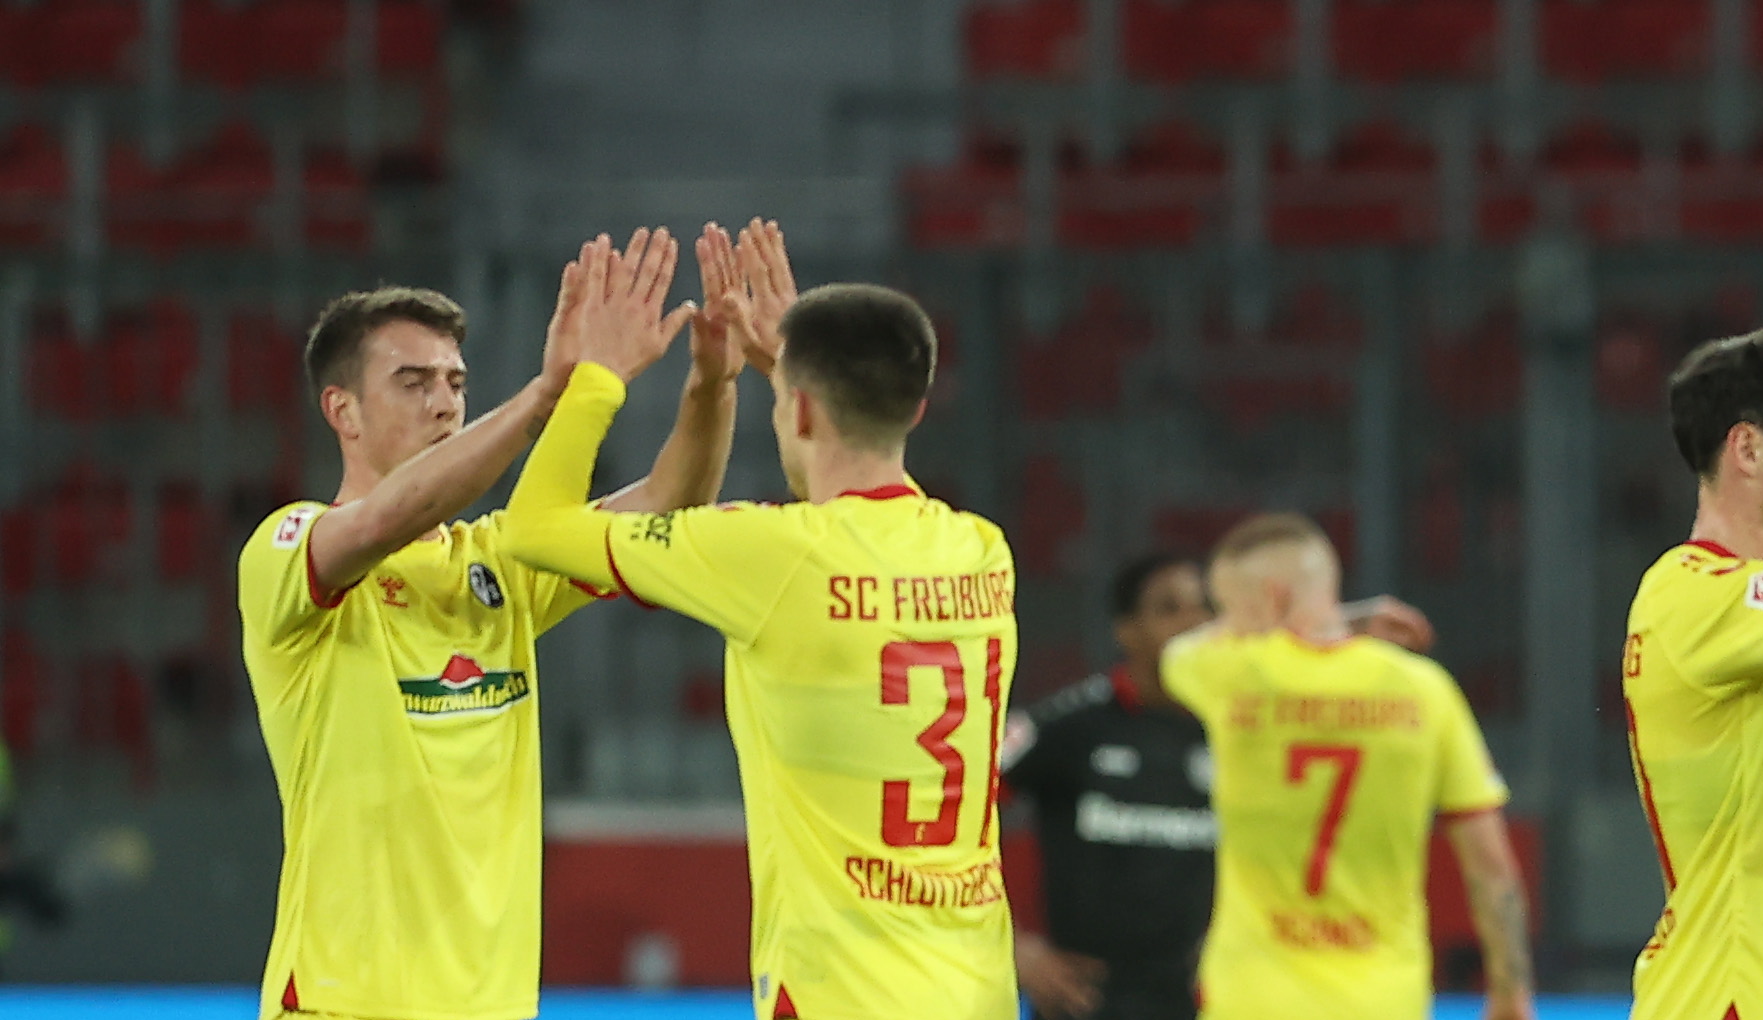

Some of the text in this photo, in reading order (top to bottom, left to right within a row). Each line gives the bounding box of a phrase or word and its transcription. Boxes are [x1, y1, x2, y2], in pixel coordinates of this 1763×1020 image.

[829, 576, 878, 621] SC
[881, 639, 1002, 848] 31
[1285, 744, 1365, 897] 7
